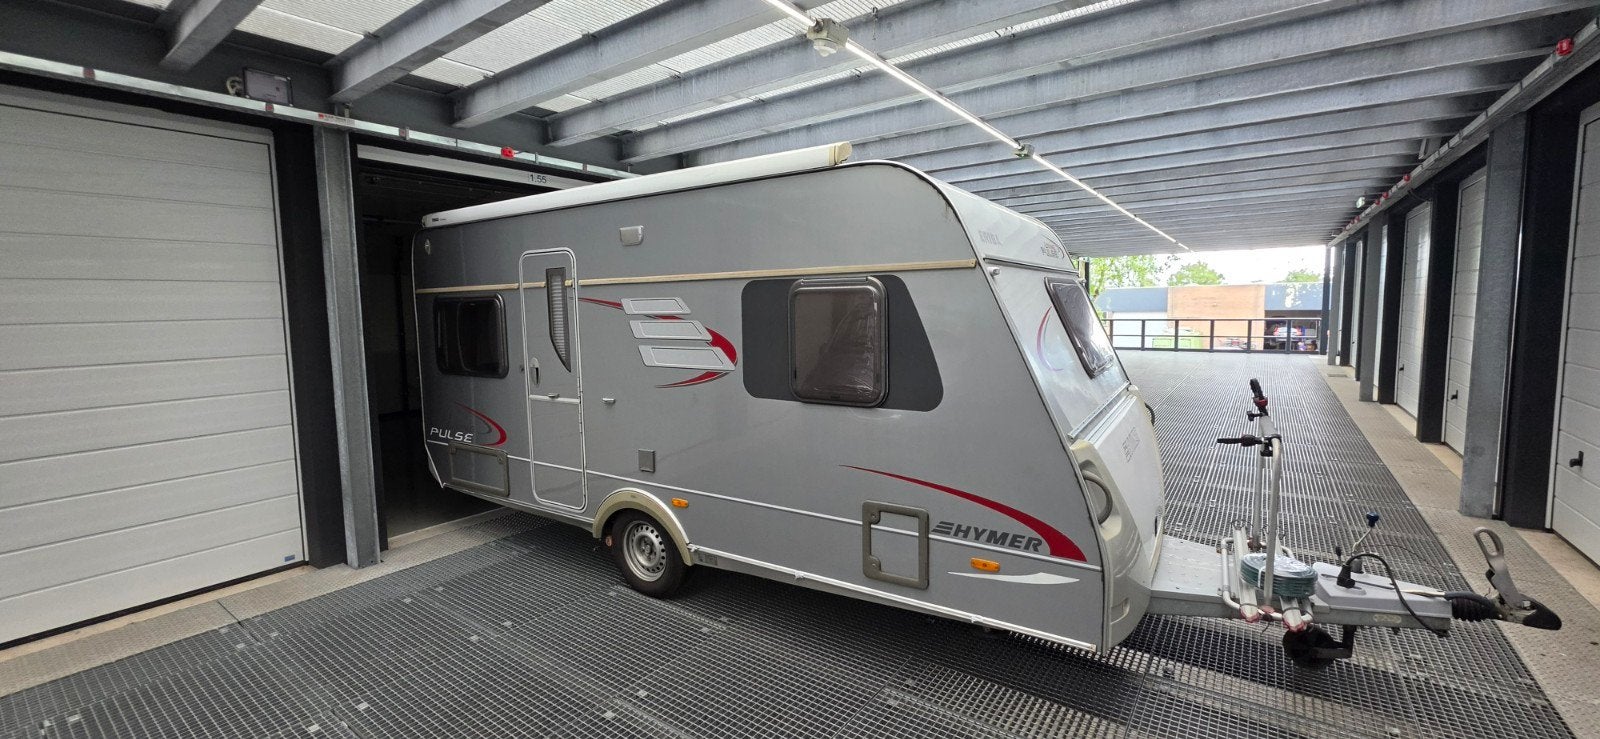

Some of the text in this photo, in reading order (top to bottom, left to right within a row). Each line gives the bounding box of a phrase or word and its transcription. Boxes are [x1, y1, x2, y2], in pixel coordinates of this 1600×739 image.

[530, 174, 547, 184] 1.55
[430, 427, 474, 443] PULSE
[953, 524, 1043, 553] HYMER
